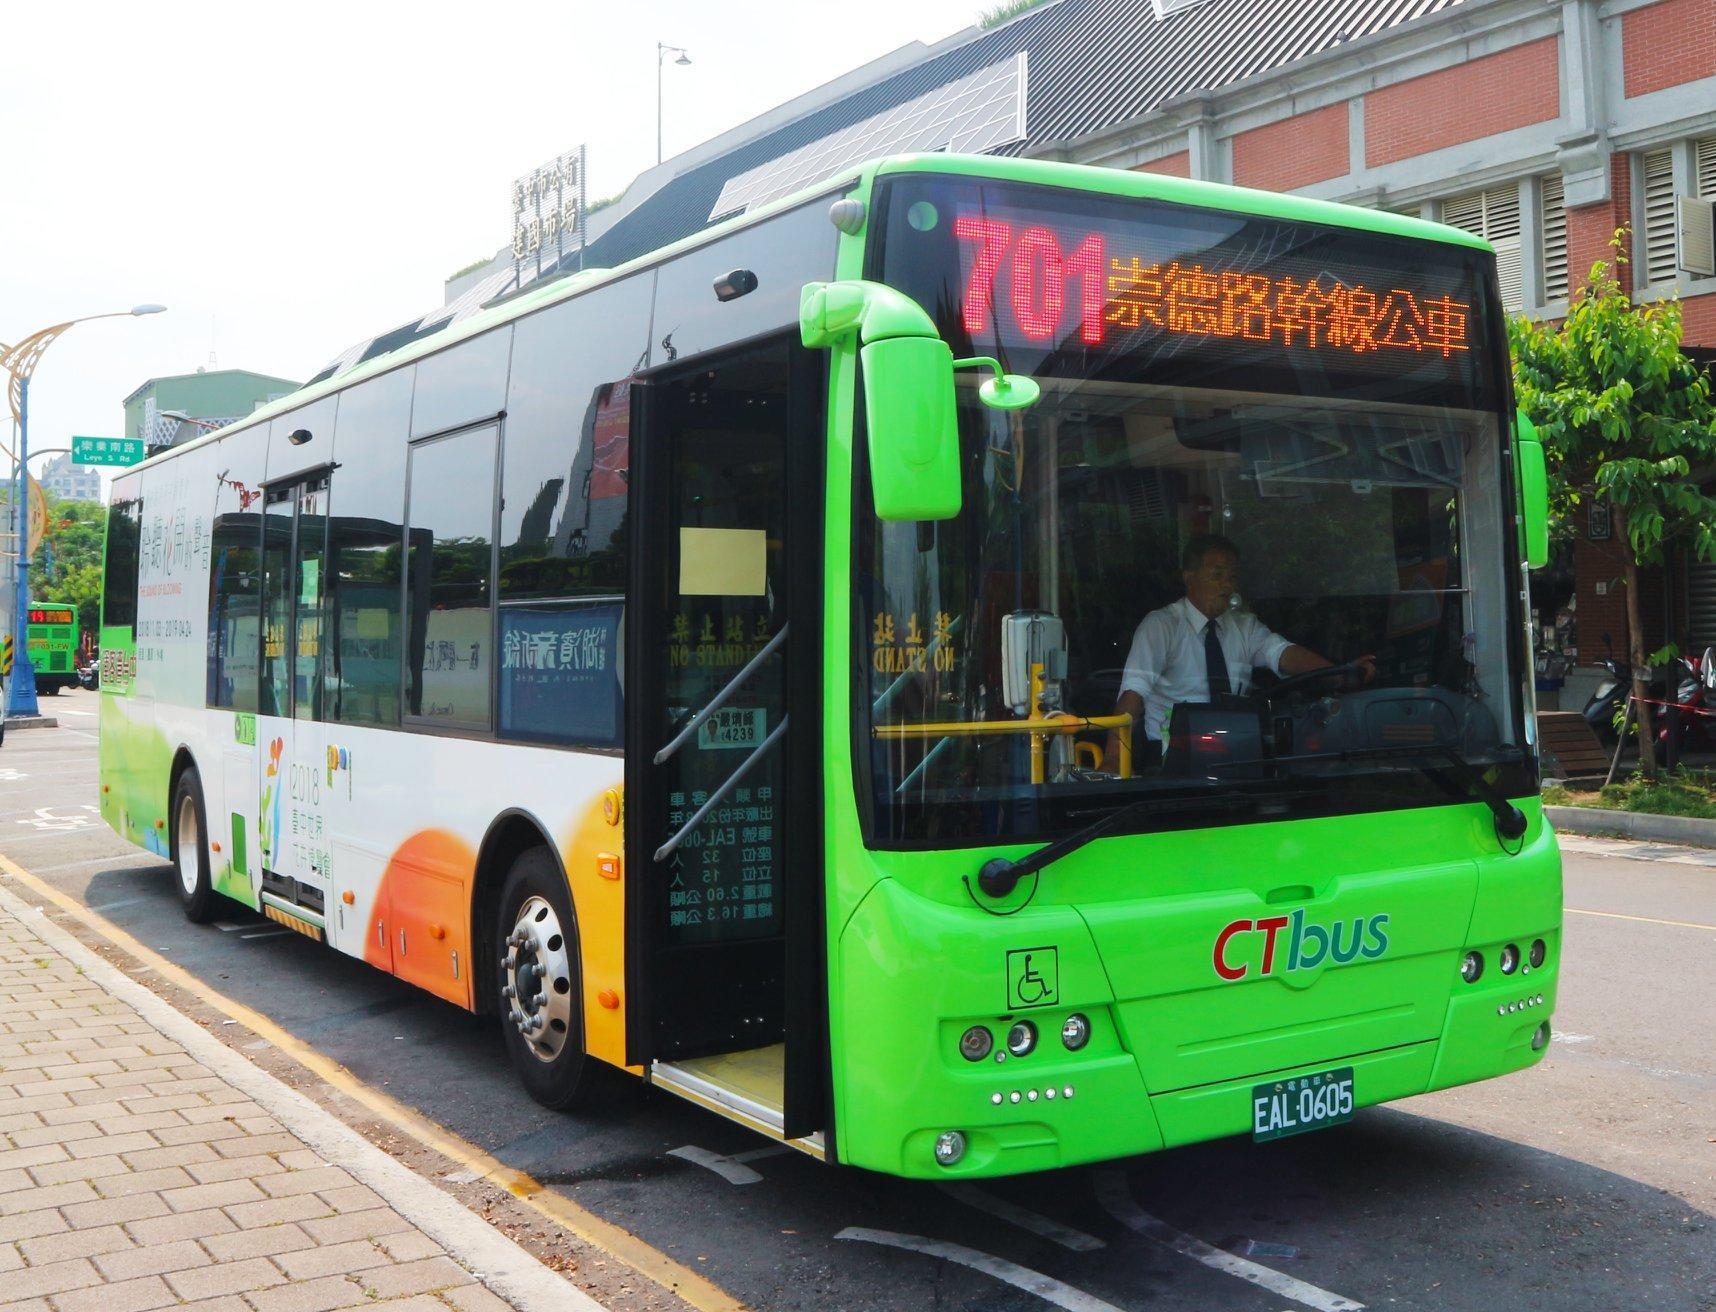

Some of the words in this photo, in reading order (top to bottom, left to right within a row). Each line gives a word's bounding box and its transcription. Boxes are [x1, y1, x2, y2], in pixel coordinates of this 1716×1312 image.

[953, 216, 1104, 345] 701
[1105, 256, 1470, 358] 崇德路幹線公車
[669, 644, 689, 667] NO
[725, 727, 754, 741] 4239
[291, 763, 320, 805] 2018
[1213, 909, 1389, 981] CTbus
[1253, 1079, 1353, 1134] EAL-0605
